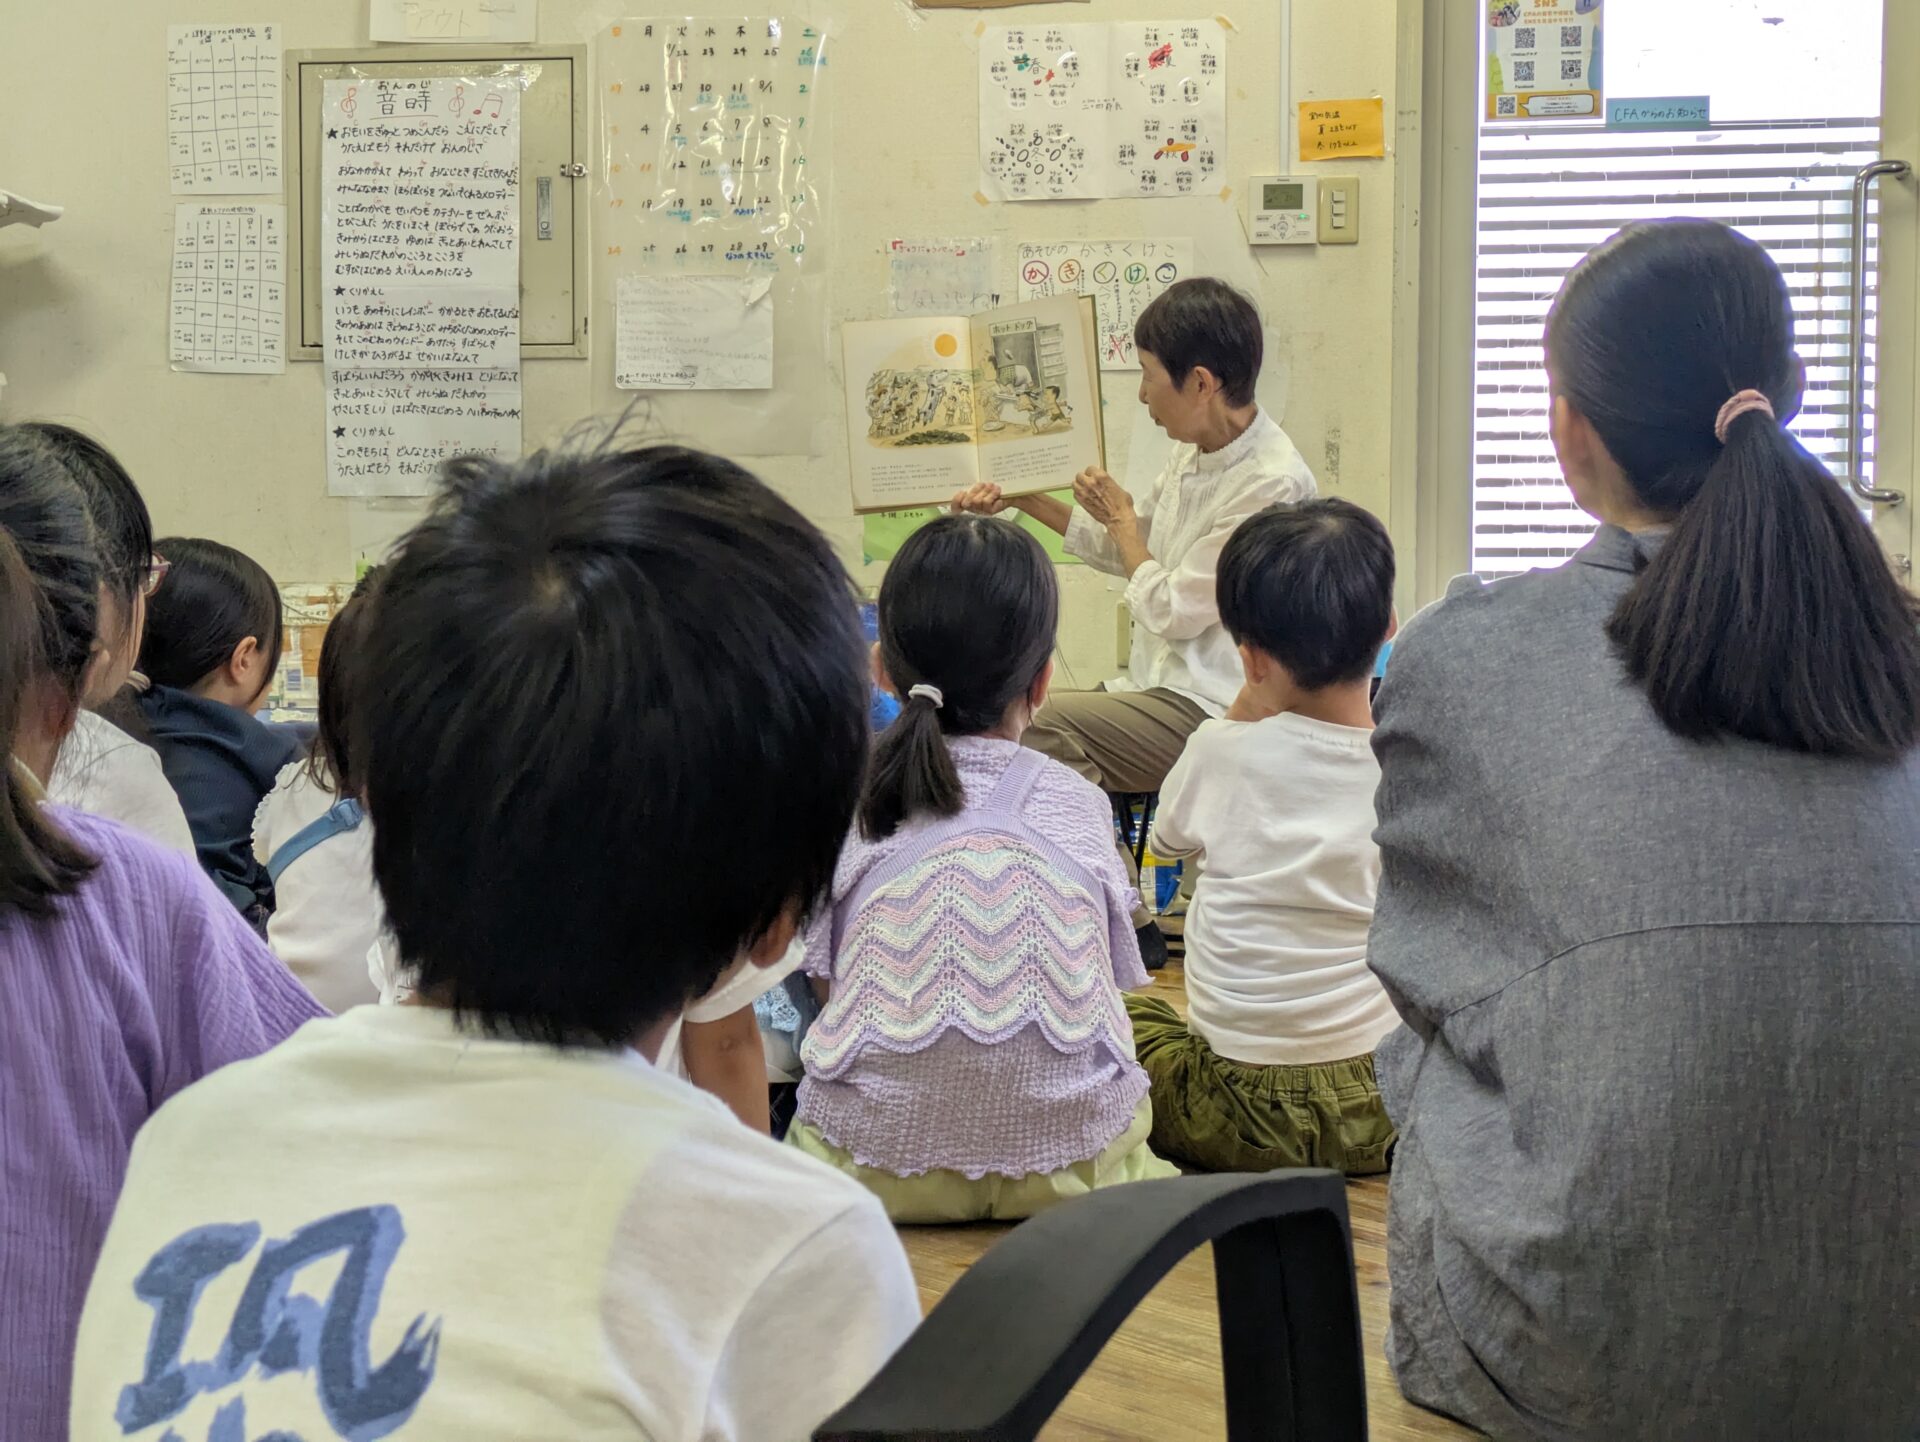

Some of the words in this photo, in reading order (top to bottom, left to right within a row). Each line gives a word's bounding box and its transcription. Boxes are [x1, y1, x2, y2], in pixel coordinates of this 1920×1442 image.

[641, 123, 649, 135] 4
[675, 123, 682, 134] 5
[702, 121, 709, 131] 6
[672, 160, 687, 170] 12
[759, 155, 771, 167] 15
[672, 198, 684, 209] 19
